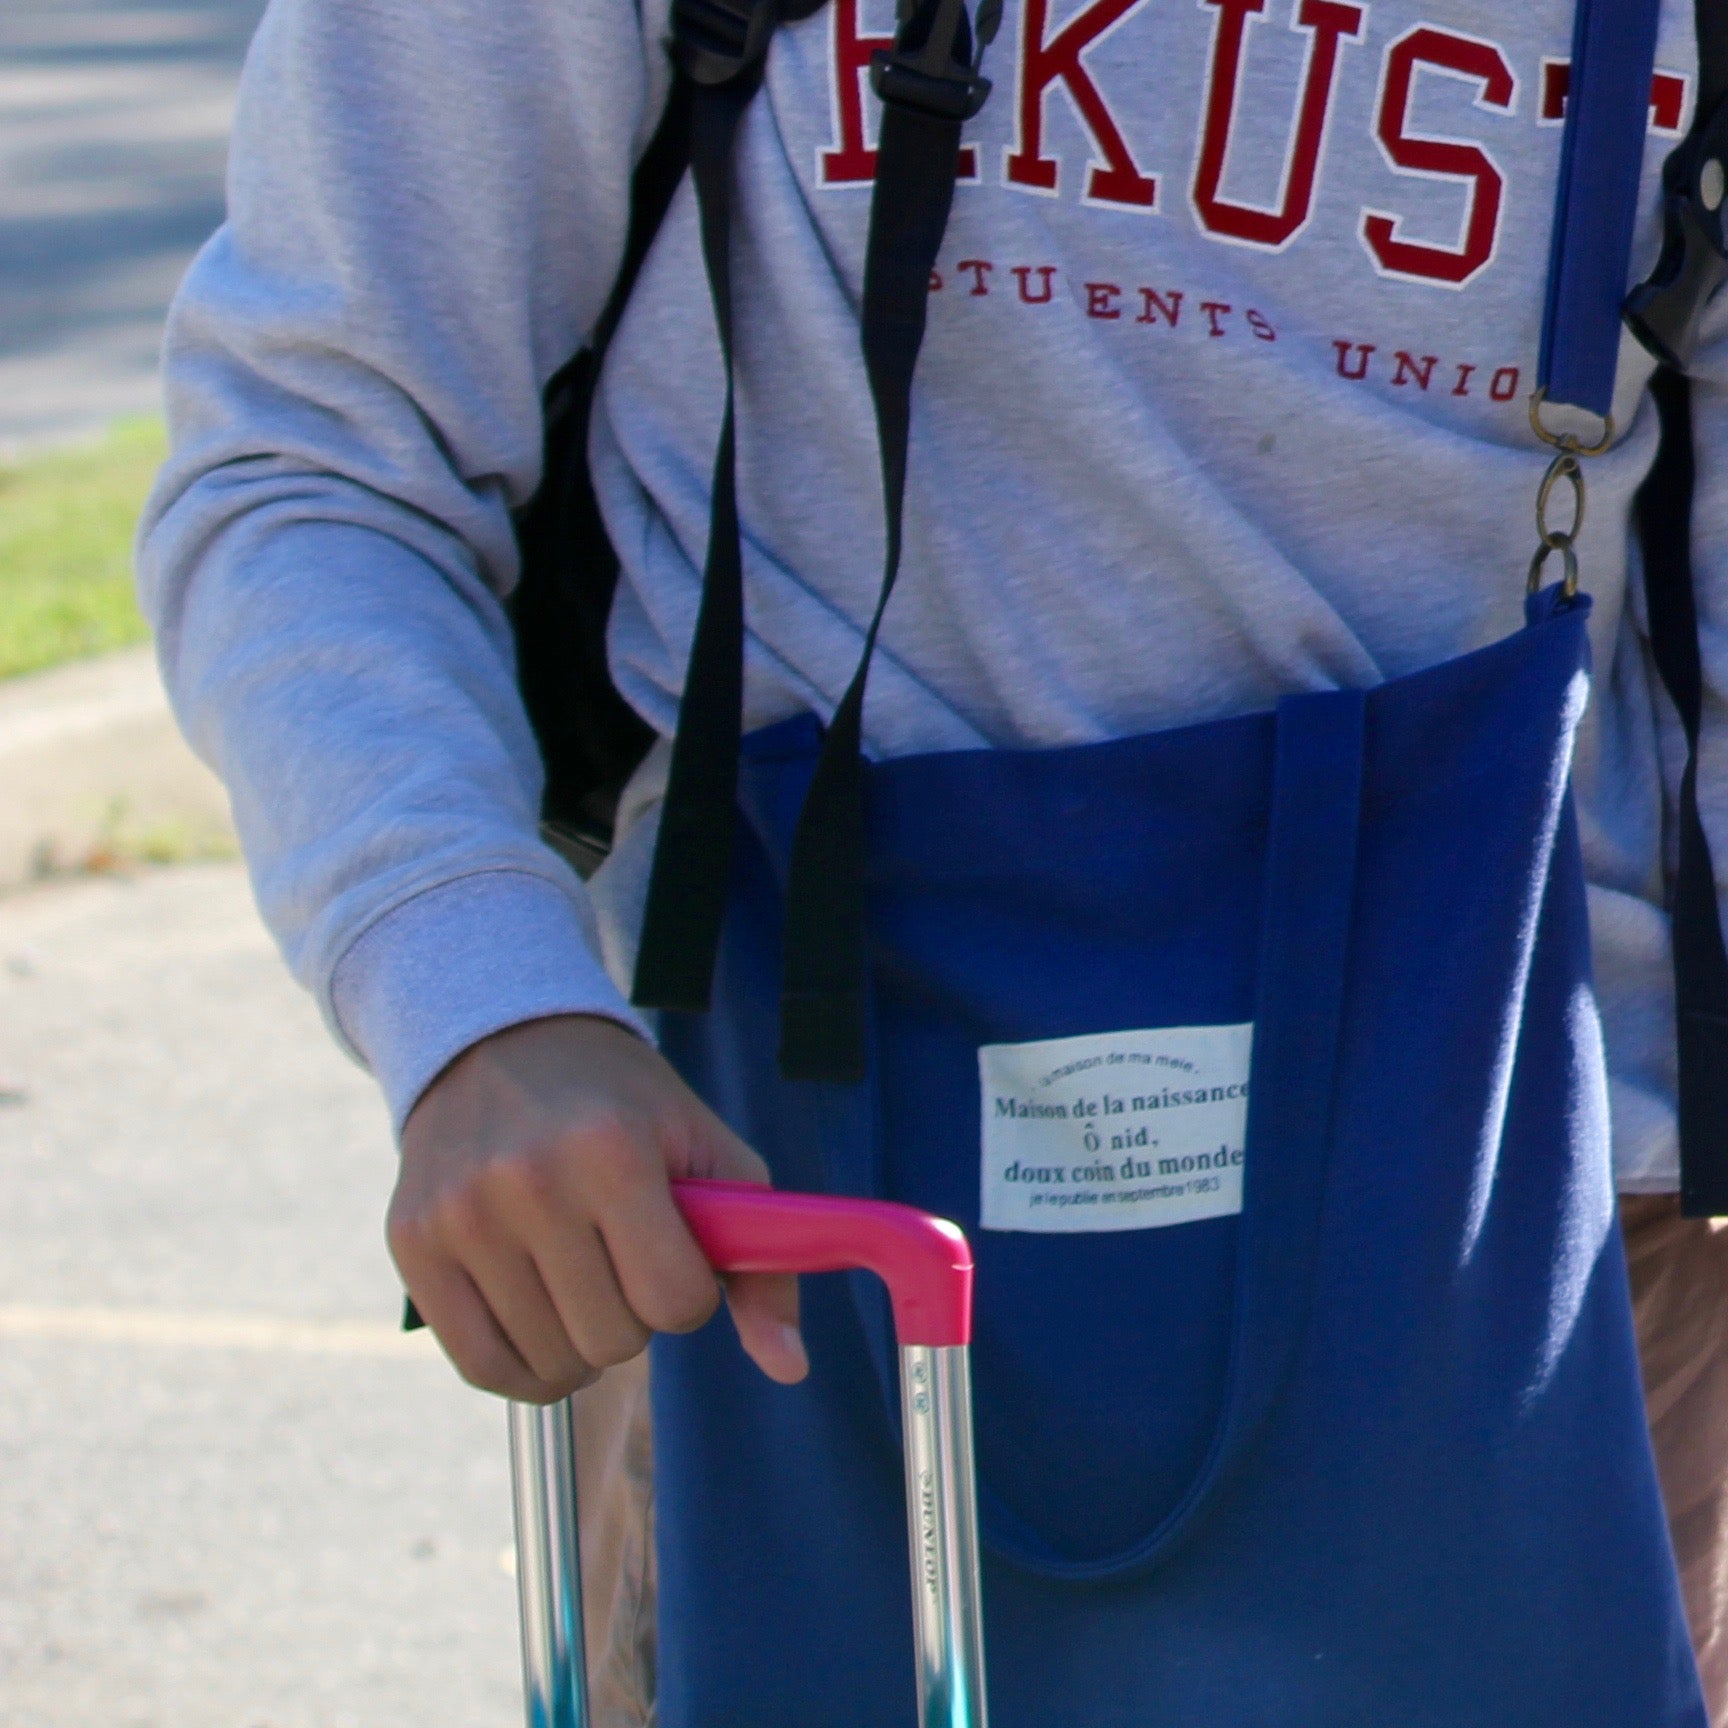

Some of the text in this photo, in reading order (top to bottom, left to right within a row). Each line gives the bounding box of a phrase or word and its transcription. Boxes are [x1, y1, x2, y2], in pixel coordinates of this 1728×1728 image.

[1332, 340, 1519, 401] UNIO
[995, 1081, 1250, 1119] Maison de la naissance
[1004, 1144, 1244, 1184] doux coin du monde
